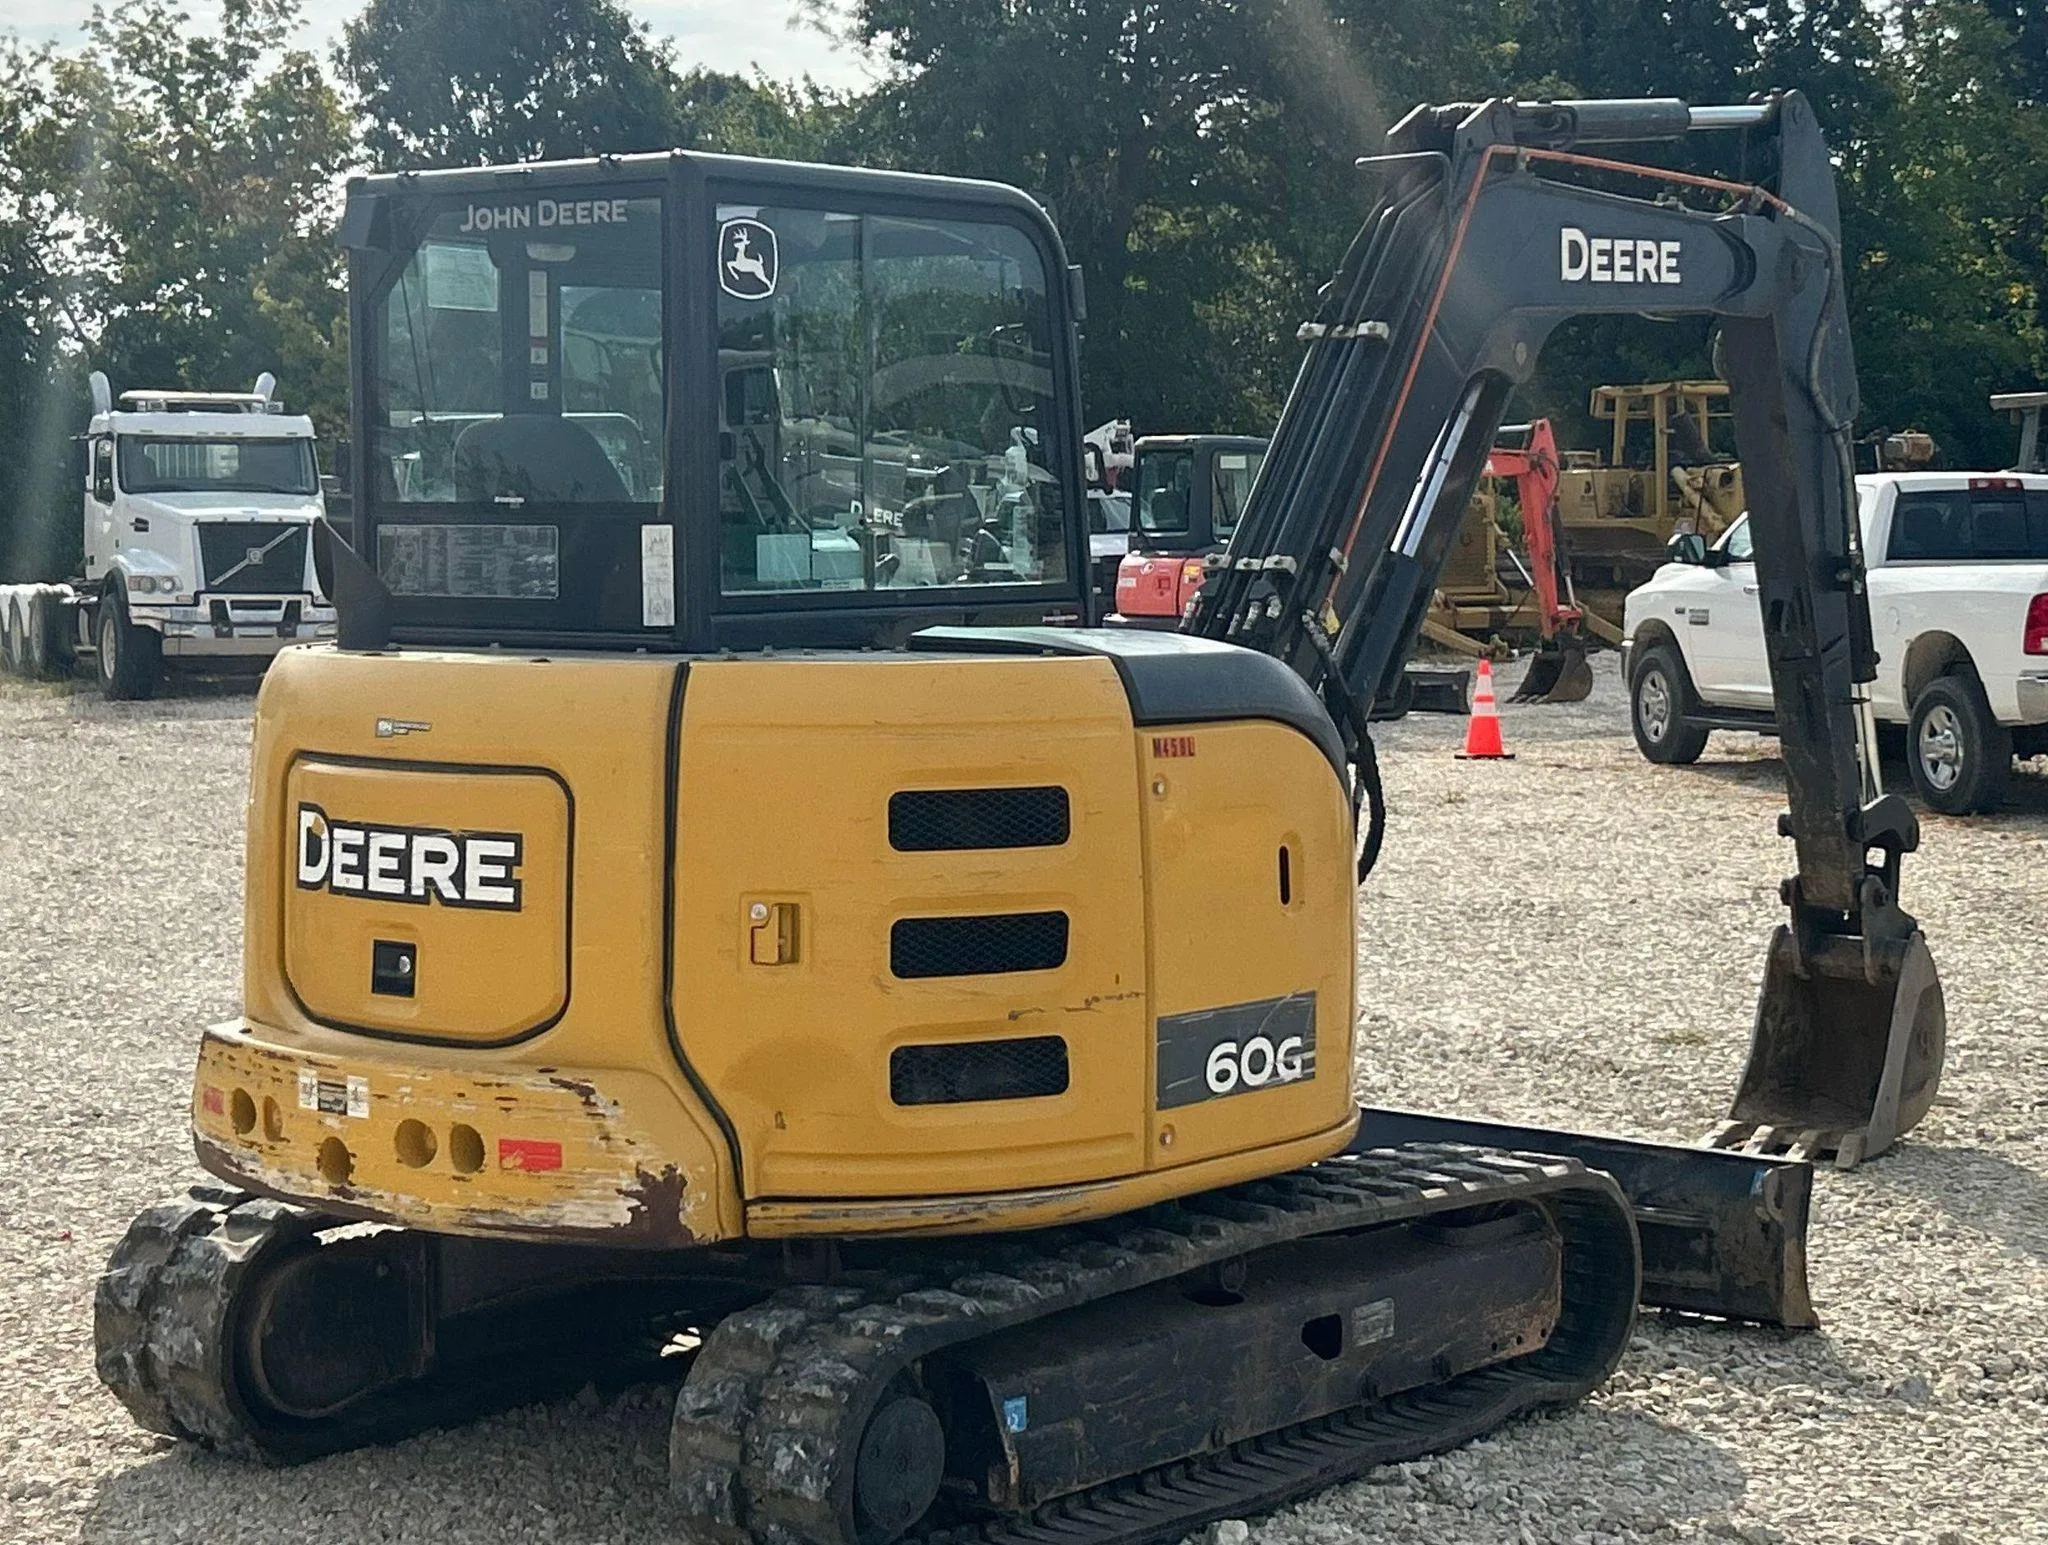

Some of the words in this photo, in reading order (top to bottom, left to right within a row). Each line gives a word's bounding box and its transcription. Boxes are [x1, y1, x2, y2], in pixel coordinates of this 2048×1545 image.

[459, 204, 531, 232] JOHN
[538, 199, 628, 227] DEERE
[1561, 227, 1681, 284] DEERE
[298, 810, 516, 903] DEERE
[1206, 1036, 1302, 1093] 60G
